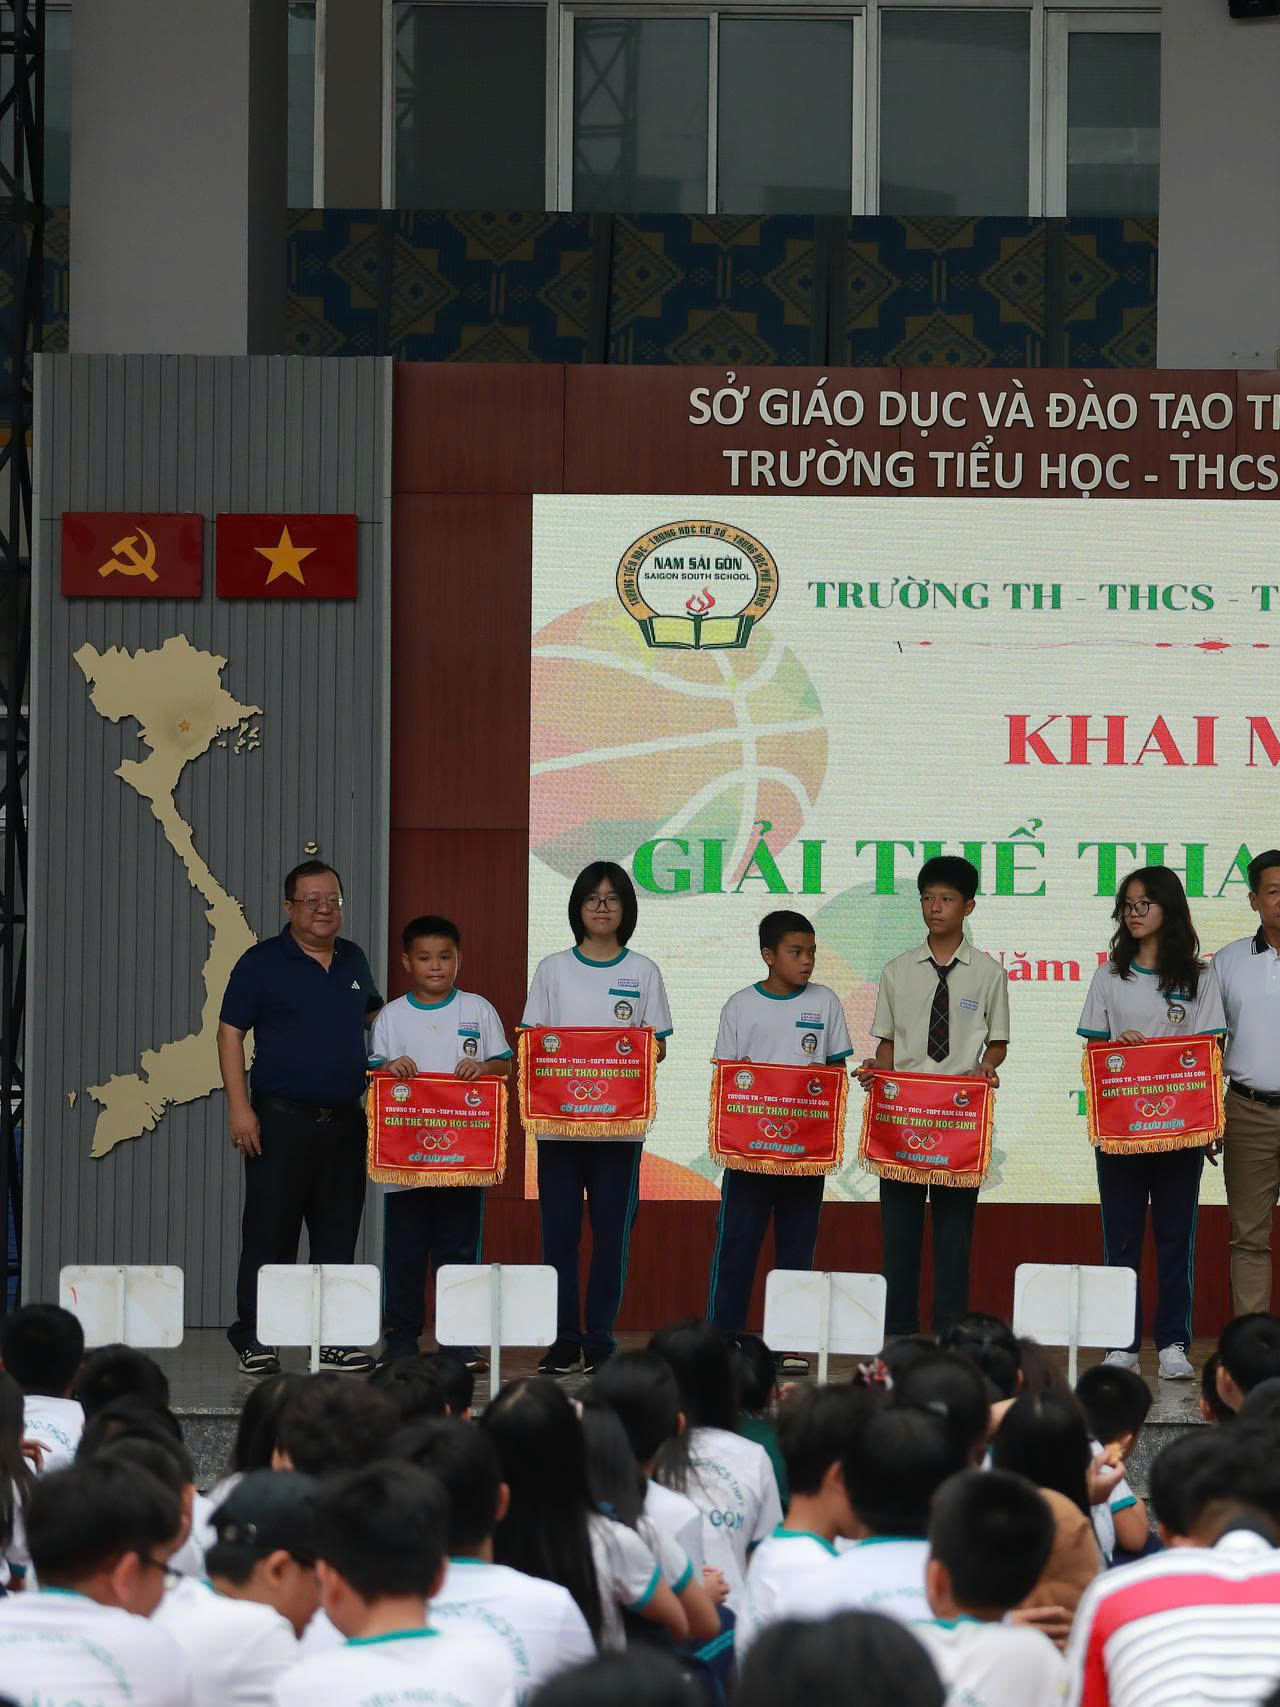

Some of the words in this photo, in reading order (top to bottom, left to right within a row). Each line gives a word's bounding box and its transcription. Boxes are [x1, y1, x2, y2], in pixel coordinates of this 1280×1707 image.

[689, 371, 751, 425] SỞ
[759, 376, 864, 427] GIÁO
[879, 391, 967, 438] DỤC
[977, 378, 1034, 428] VÀ
[1045, 378, 1138, 430] ĐÀO
[1149, 393, 1233, 439] TẠO
[722, 438, 915, 488] TRƯỜNG
[928, 434, 1023, 489] TIỂU
[1040, 453, 1130, 498] HỌC
[1169, 453, 1279, 492] THCS
[654, 557, 684, 570] NAM
[689, 554, 710, 570] SÀI
[715, 555, 742, 570] GÒN
[808, 576, 989, 610] TRƯỜNG
[1003, 583, 1062, 610] TH
[1099, 583, 1215, 612] THCS
[1003, 713, 1219, 766] KHAI
[632, 820, 826, 896] GIẢI
[620, 1069, 640, 1077] SINH
[1141, 1086, 1164, 1094] THAO
[1186, 1081, 1206, 1089] SINH
[767, 1106, 788, 1115] THAO
[810, 1110, 828, 1118] SINH
[424, 1118, 446, 1126] THAO
[470, 1120, 490, 1128] SINH
[911, 1118, 932, 1127] THAO
[956, 1121, 976, 1130] SINH
